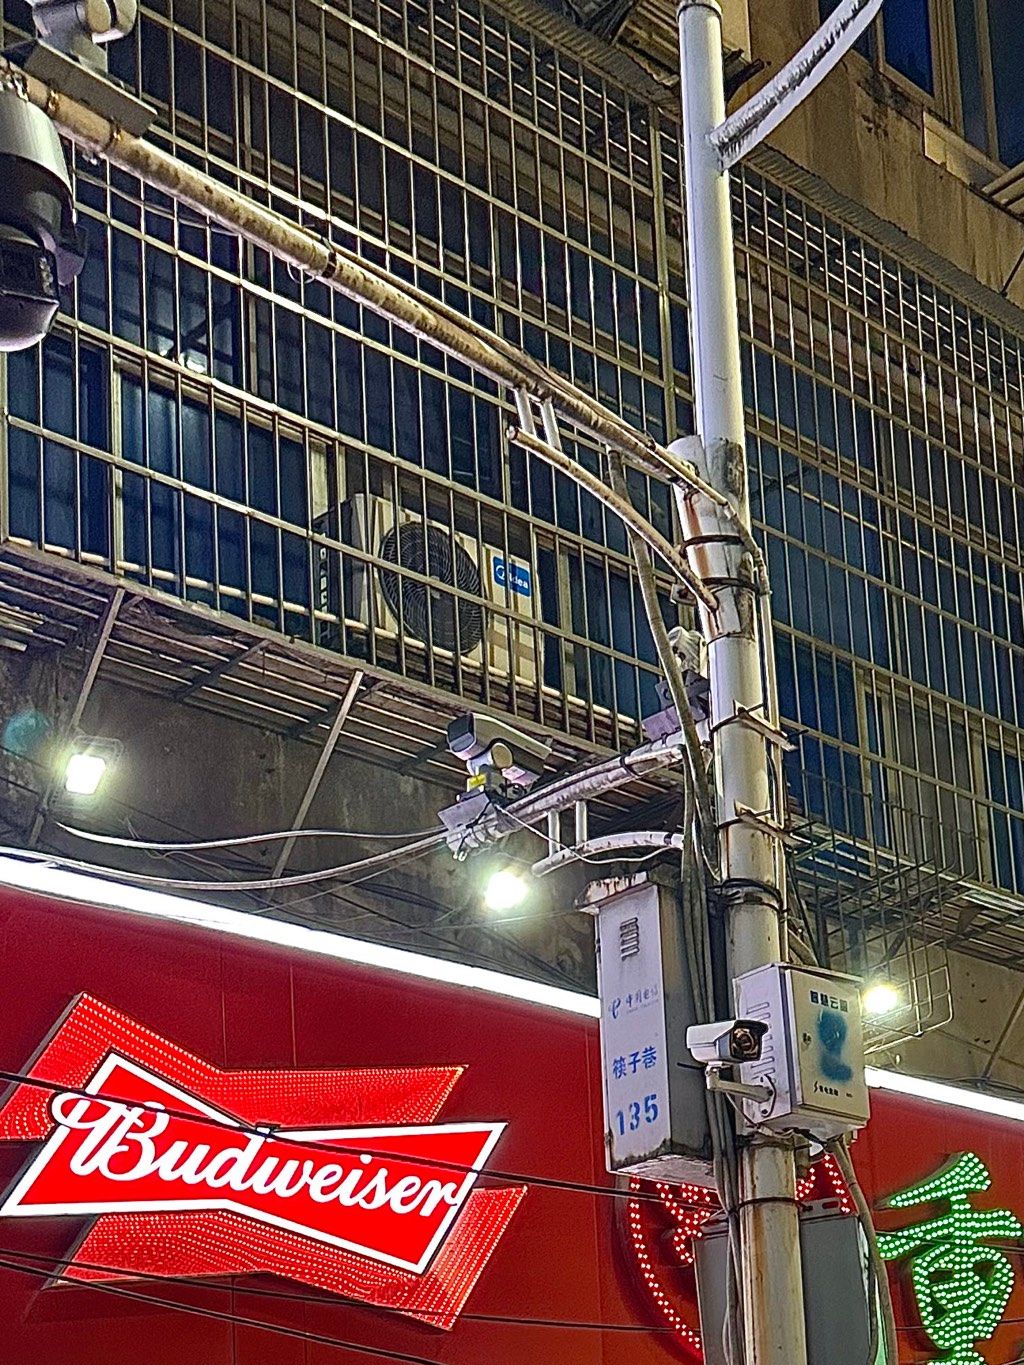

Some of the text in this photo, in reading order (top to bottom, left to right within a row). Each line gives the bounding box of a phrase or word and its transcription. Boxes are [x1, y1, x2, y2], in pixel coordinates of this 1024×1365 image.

[612, 1046, 658, 1080] 筷子巷
[615, 1093, 659, 1136] 135
[52, 1088, 463, 1220] Budweiser
